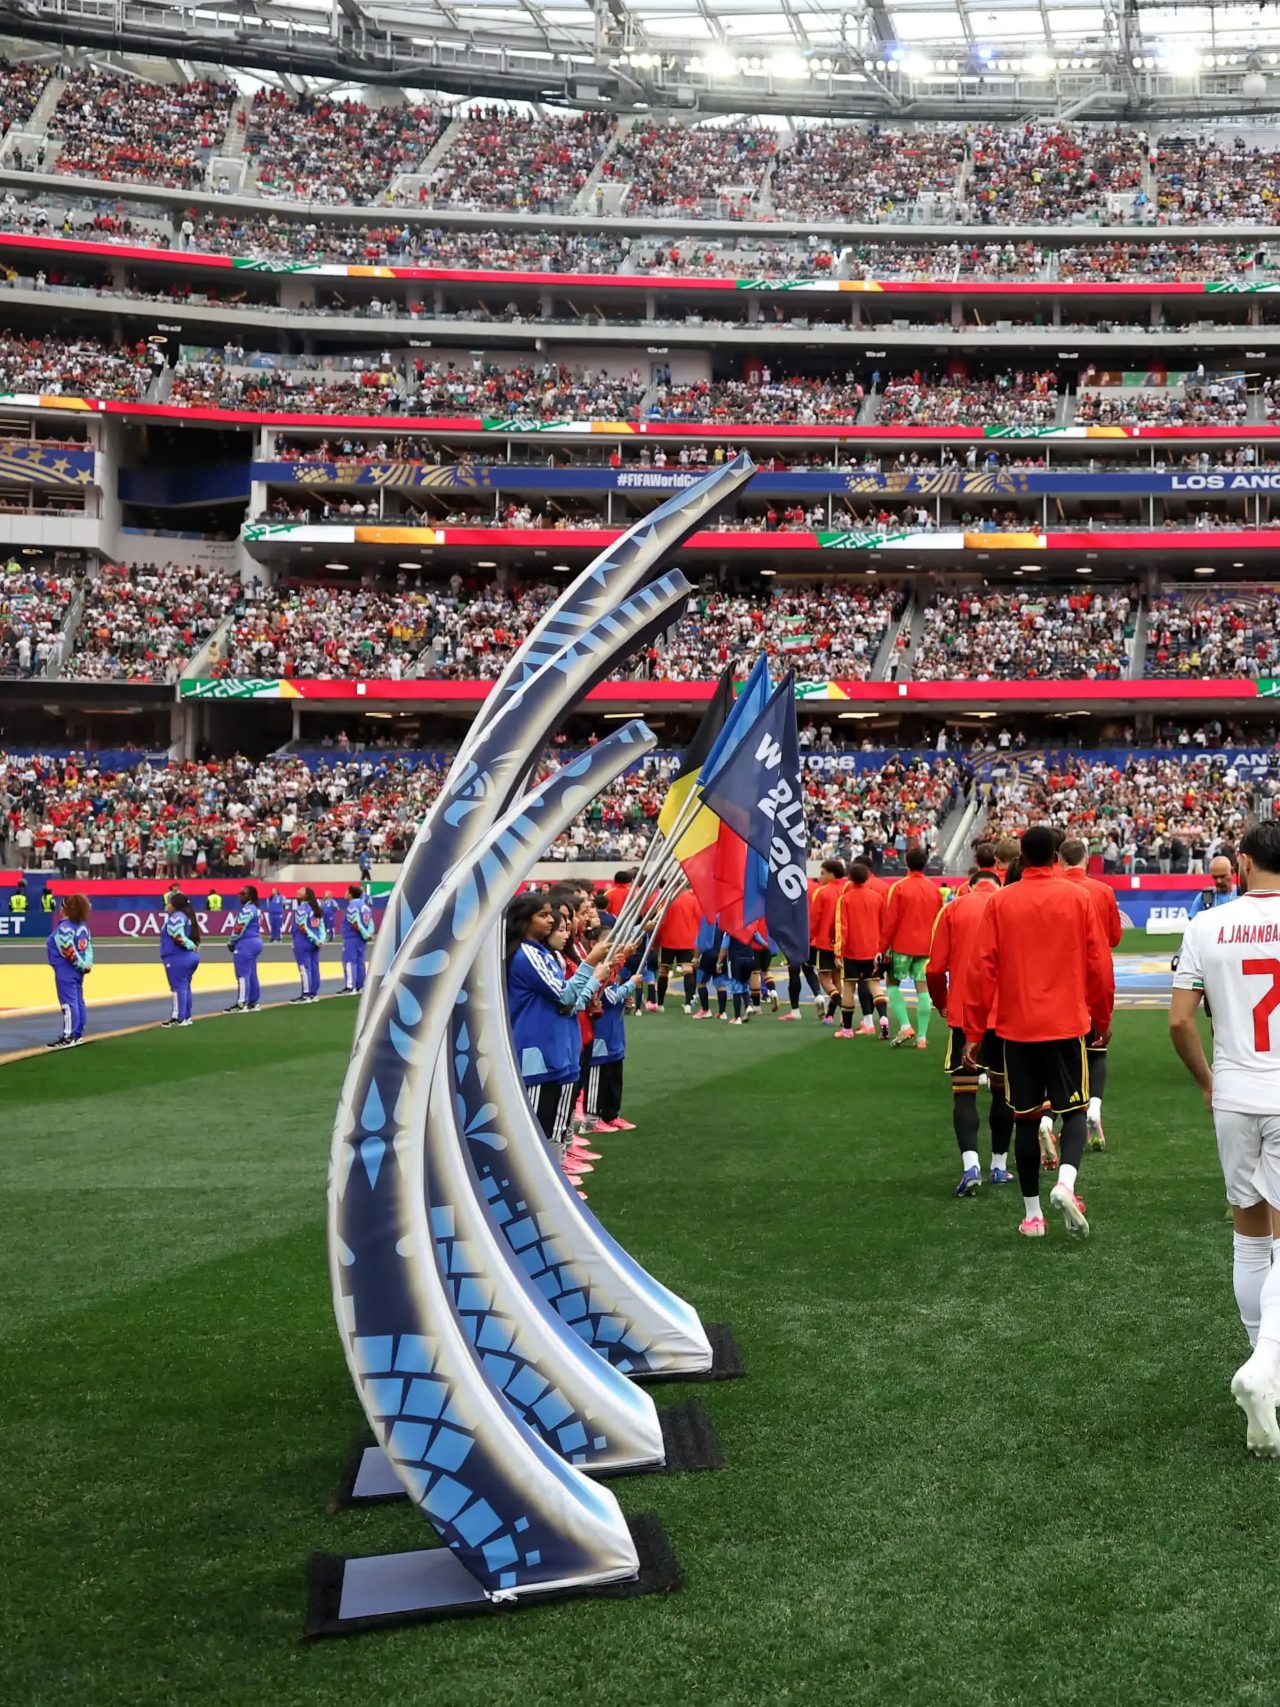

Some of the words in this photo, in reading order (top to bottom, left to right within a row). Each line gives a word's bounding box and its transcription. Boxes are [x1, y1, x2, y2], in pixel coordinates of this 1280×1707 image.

[617, 473, 704, 488] #FIFAWorldCu
[1171, 475, 1224, 489] LOS
[1149, 906, 1189, 919] FIFA
